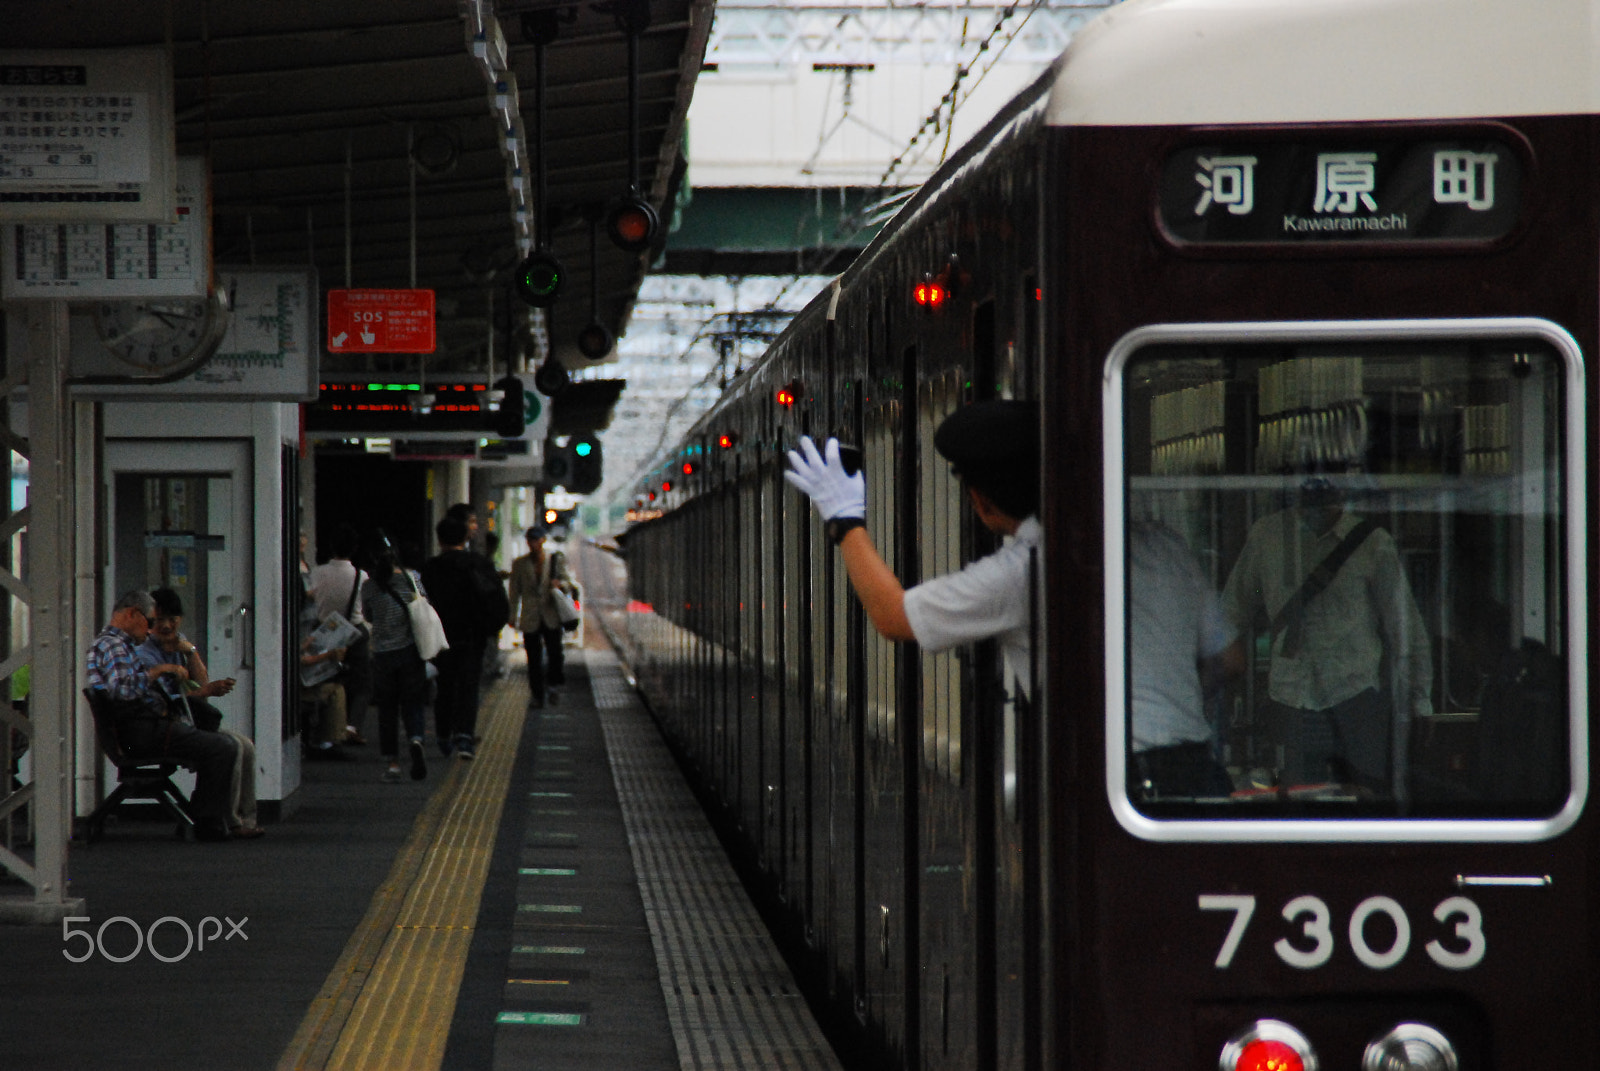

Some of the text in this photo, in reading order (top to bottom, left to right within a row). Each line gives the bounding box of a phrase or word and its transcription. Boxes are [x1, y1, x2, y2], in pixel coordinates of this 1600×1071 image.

[20, 167, 34, 177] 15
[1195, 151, 1499, 216] 河原町
[1283, 213, 1408, 232] Kawaramachi
[353, 311, 383, 323] SOS
[1198, 895, 1487, 969] 7303
